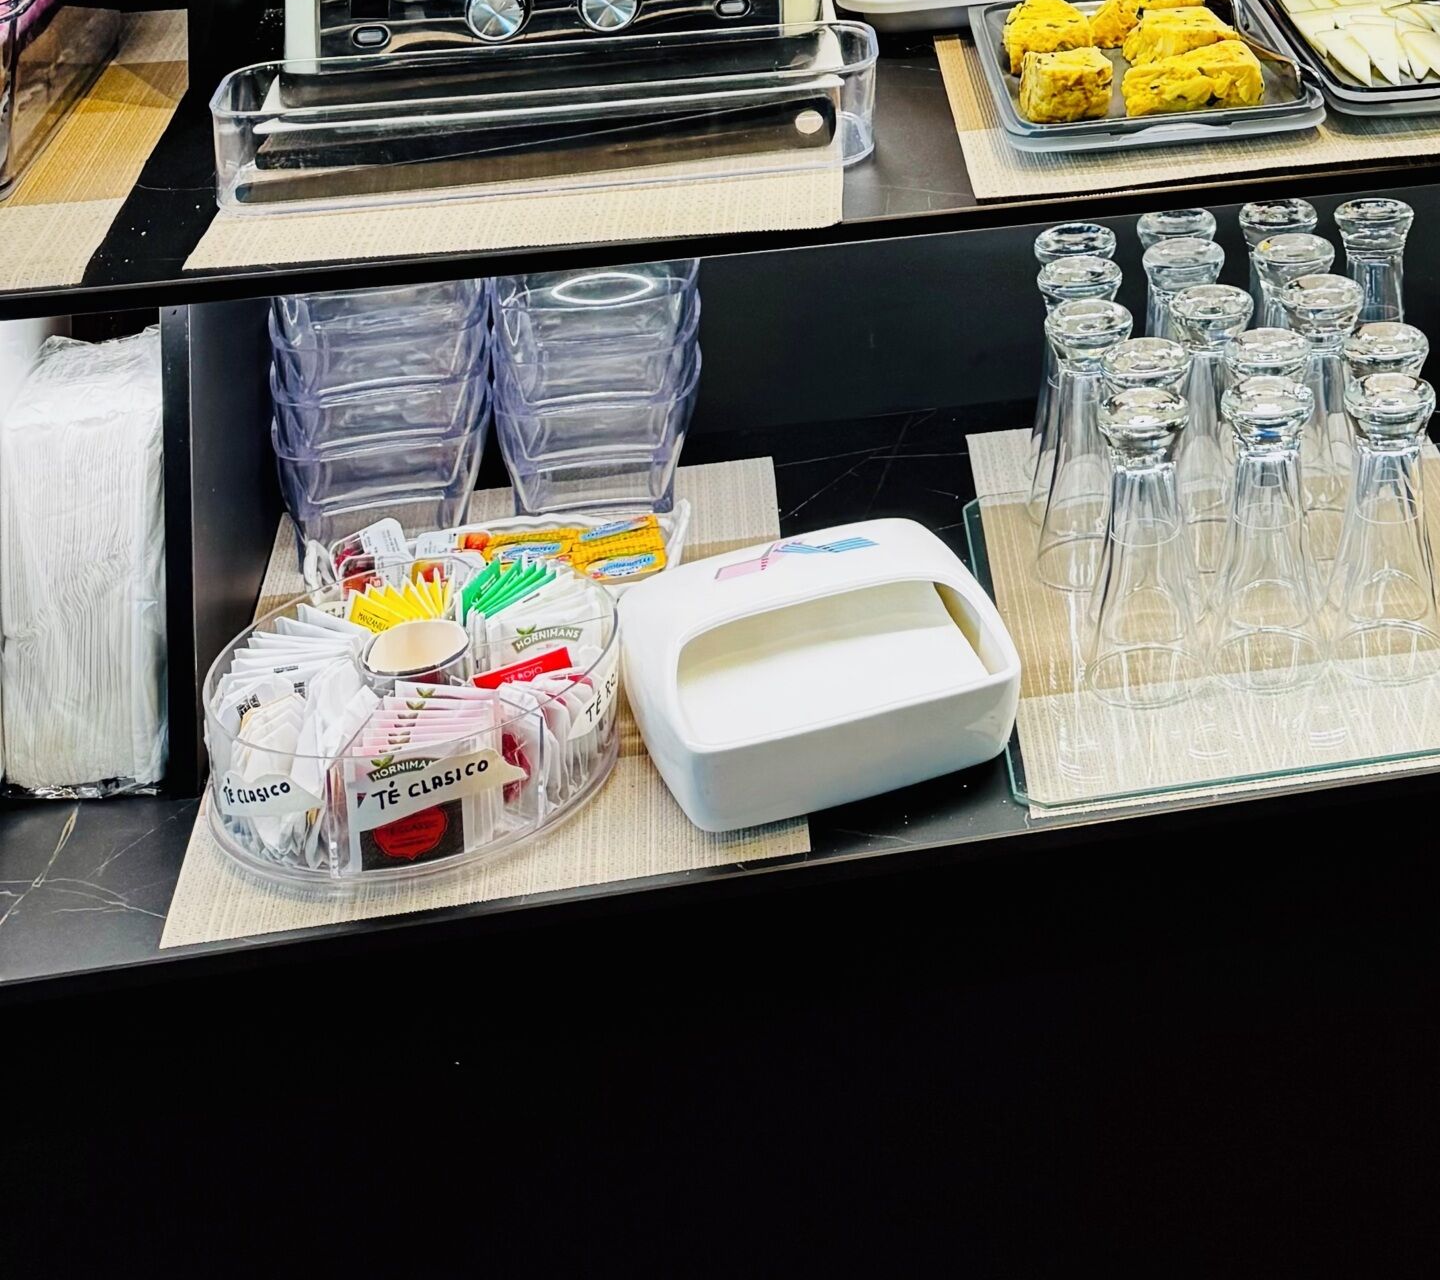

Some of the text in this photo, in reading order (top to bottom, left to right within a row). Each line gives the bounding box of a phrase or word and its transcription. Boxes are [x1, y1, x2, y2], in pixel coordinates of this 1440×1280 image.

[223, 777, 291, 806] TÉ CLASICO
[371, 759, 489, 810] TÉ CLASICO
